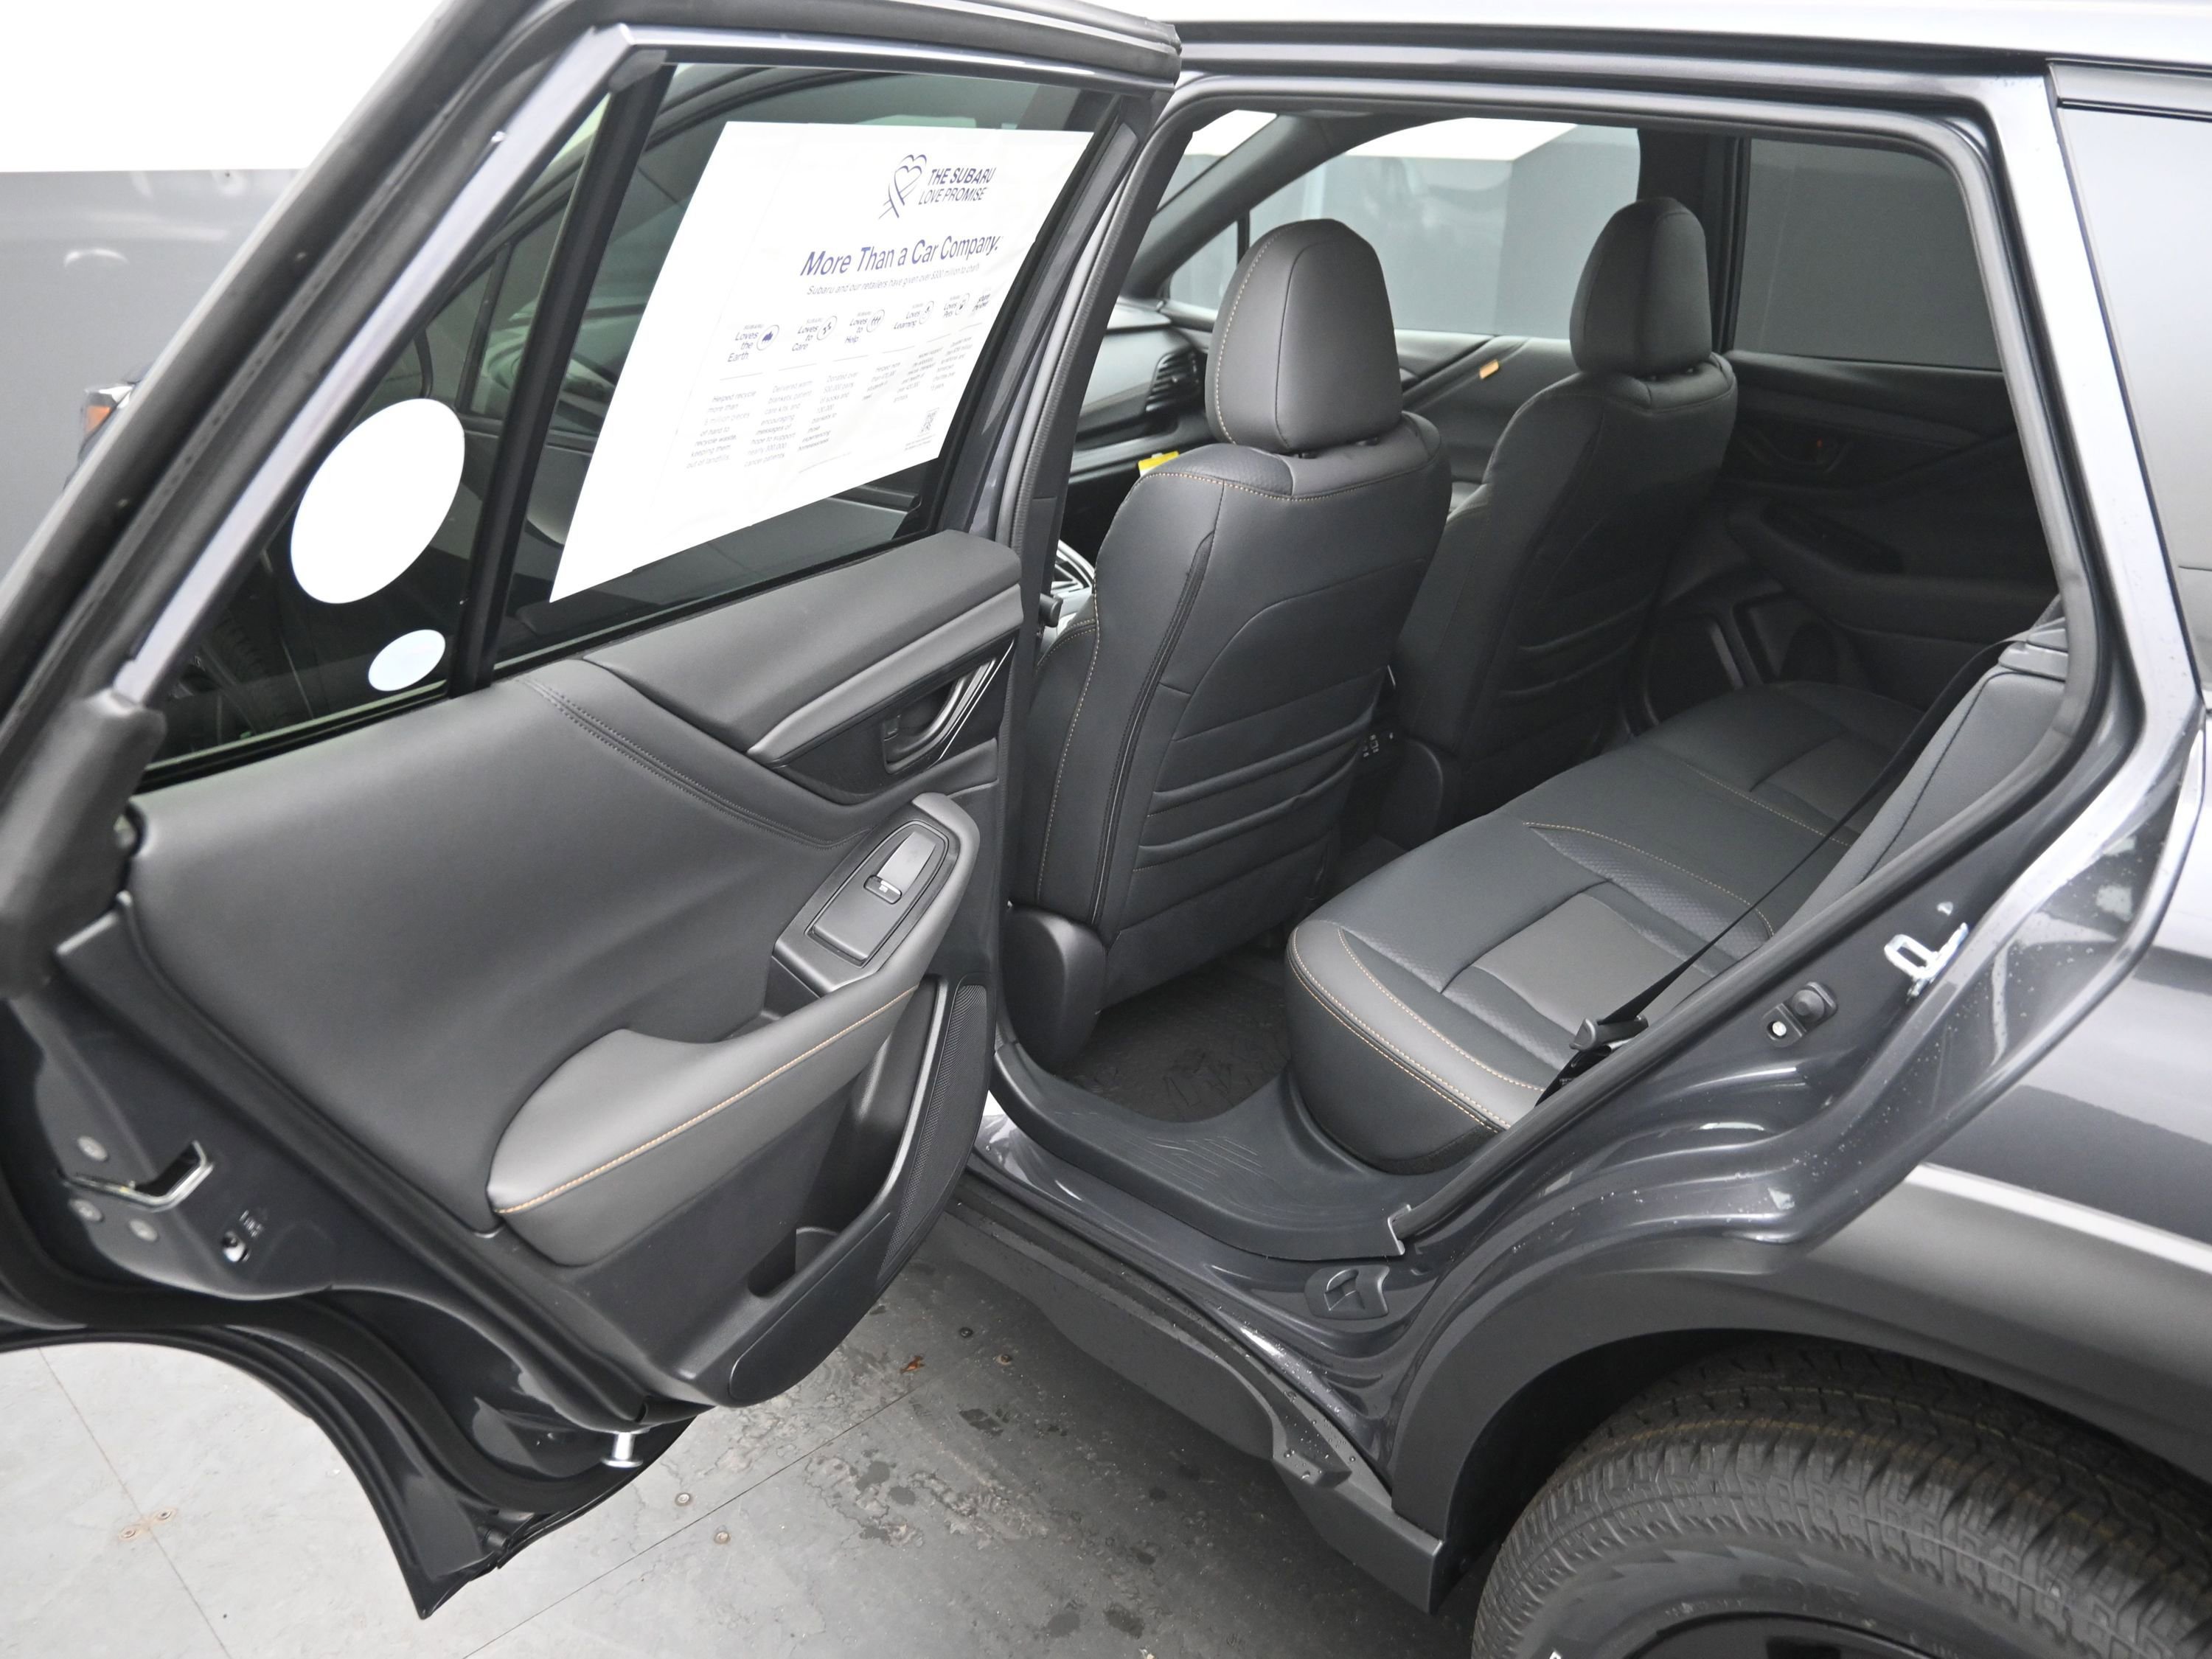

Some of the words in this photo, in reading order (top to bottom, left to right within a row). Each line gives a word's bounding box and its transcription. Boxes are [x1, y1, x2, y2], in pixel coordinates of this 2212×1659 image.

[928, 168, 951, 186] THE
[950, 167, 997, 184] SUBARU
[918, 188, 944, 205] LOVE
[942, 187, 987, 202] PROMISE
[800, 251, 852, 276] More
[857, 246, 895, 271] Than
[897, 248, 908, 266] a
[911, 239, 939, 264] Car
[806, 285, 834, 295] Subaru
[835, 285, 848, 293] and
[849, 284, 861, 292] our
[861, 279, 888, 291] retailers
[849, 317, 867, 327] Loves
[798, 325, 819, 334] Loves
[735, 332, 759, 341] Loves
[844, 335, 859, 344] Help
[741, 341, 754, 350] the
[792, 342, 808, 352] Care
